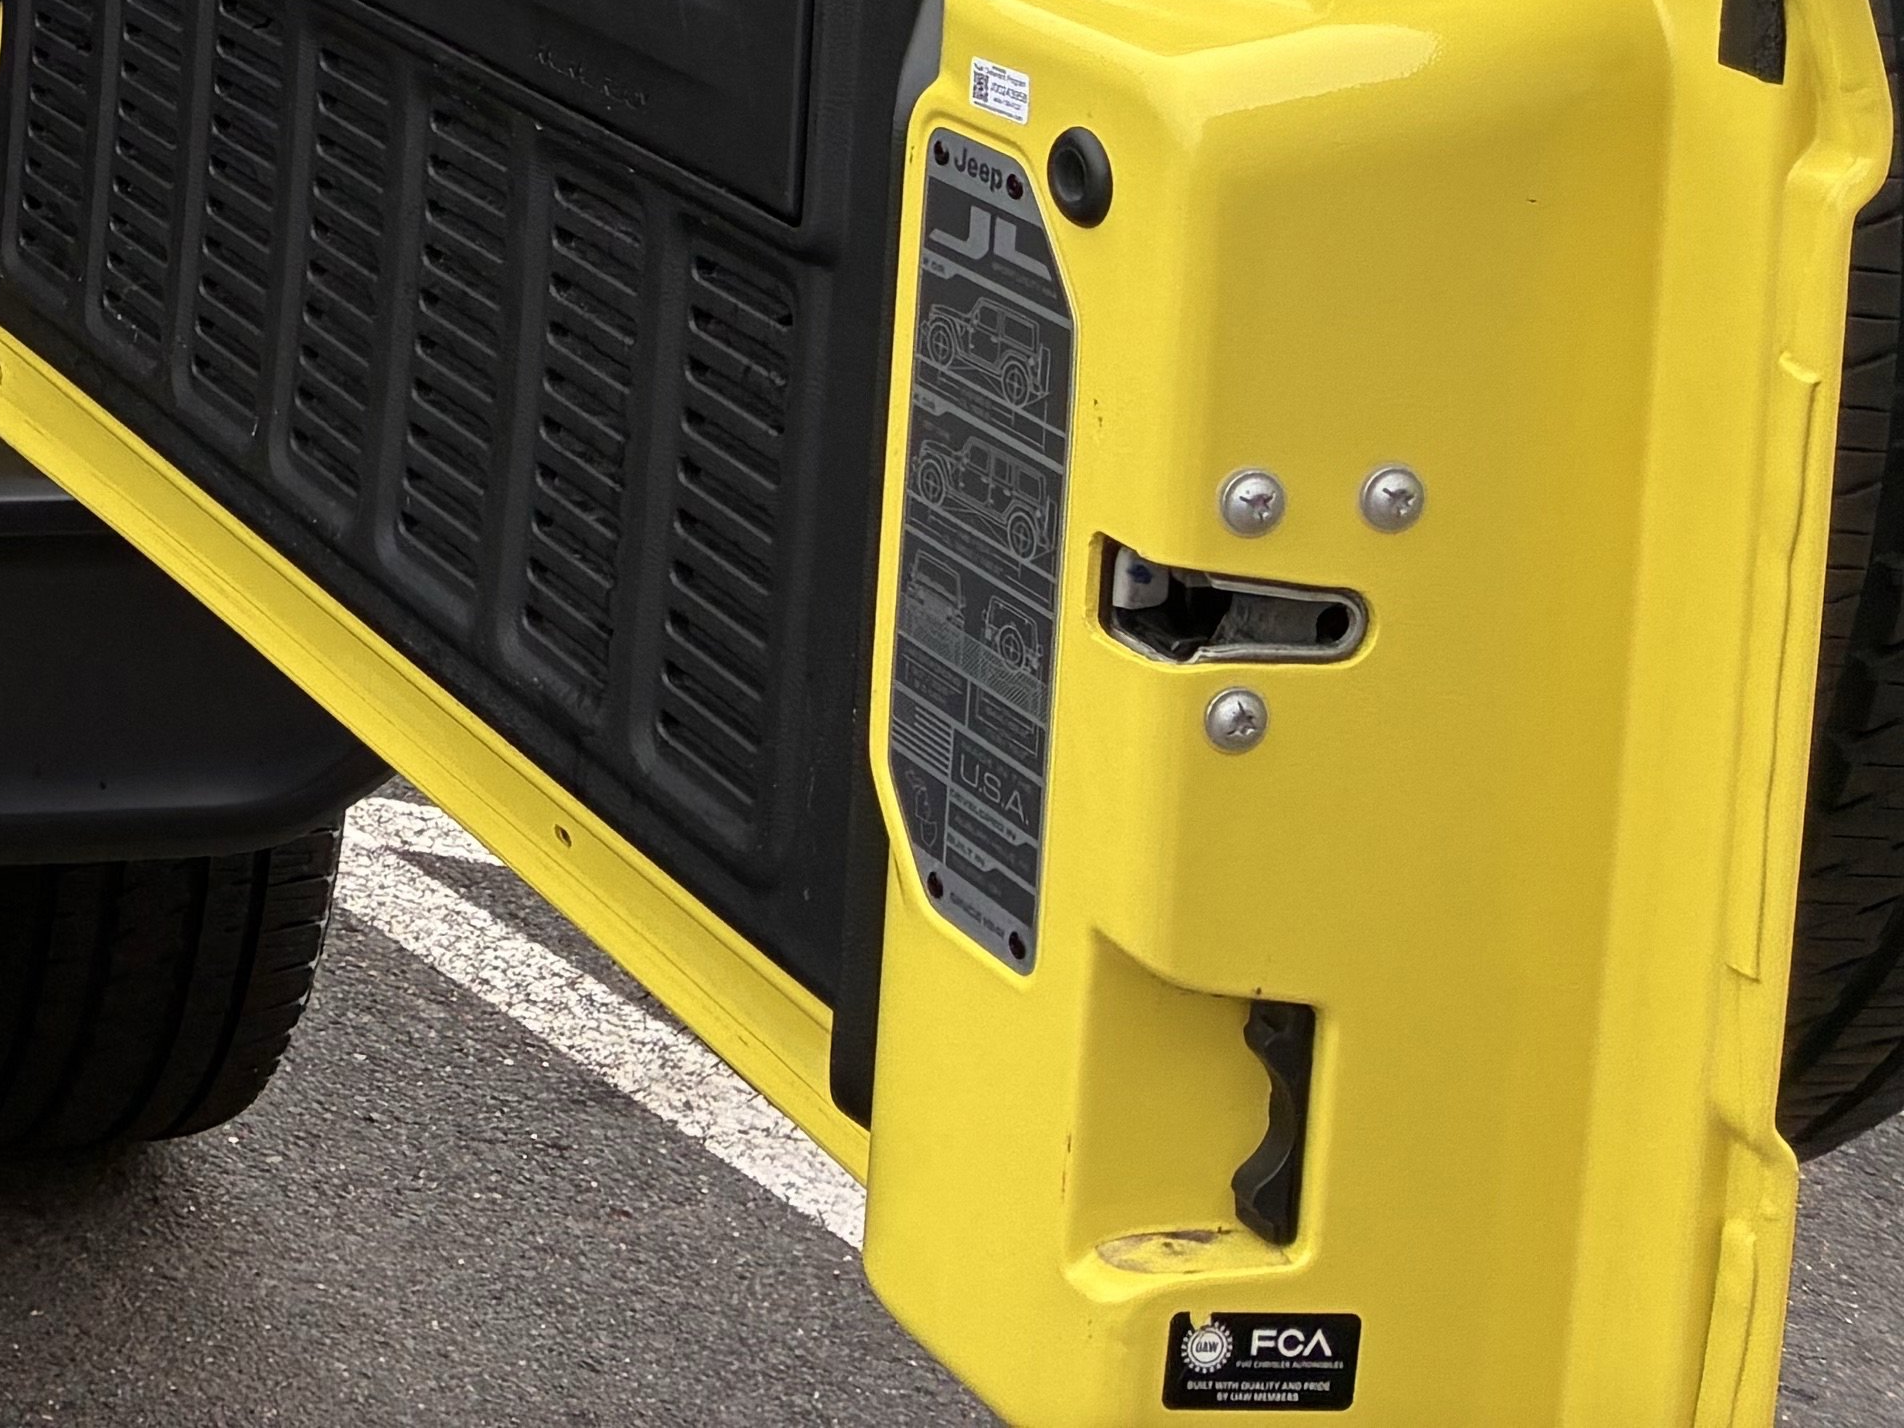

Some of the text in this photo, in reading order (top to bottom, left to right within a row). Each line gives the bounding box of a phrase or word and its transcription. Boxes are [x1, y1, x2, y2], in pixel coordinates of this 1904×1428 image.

[953, 148, 1003, 192] Jeep
[928, 204, 1053, 282] JL
[1250, 1328, 1333, 1357] FCA
[1241, 1381, 1280, 1391] QUALITY
[1281, 1381, 1302, 1391] AND
